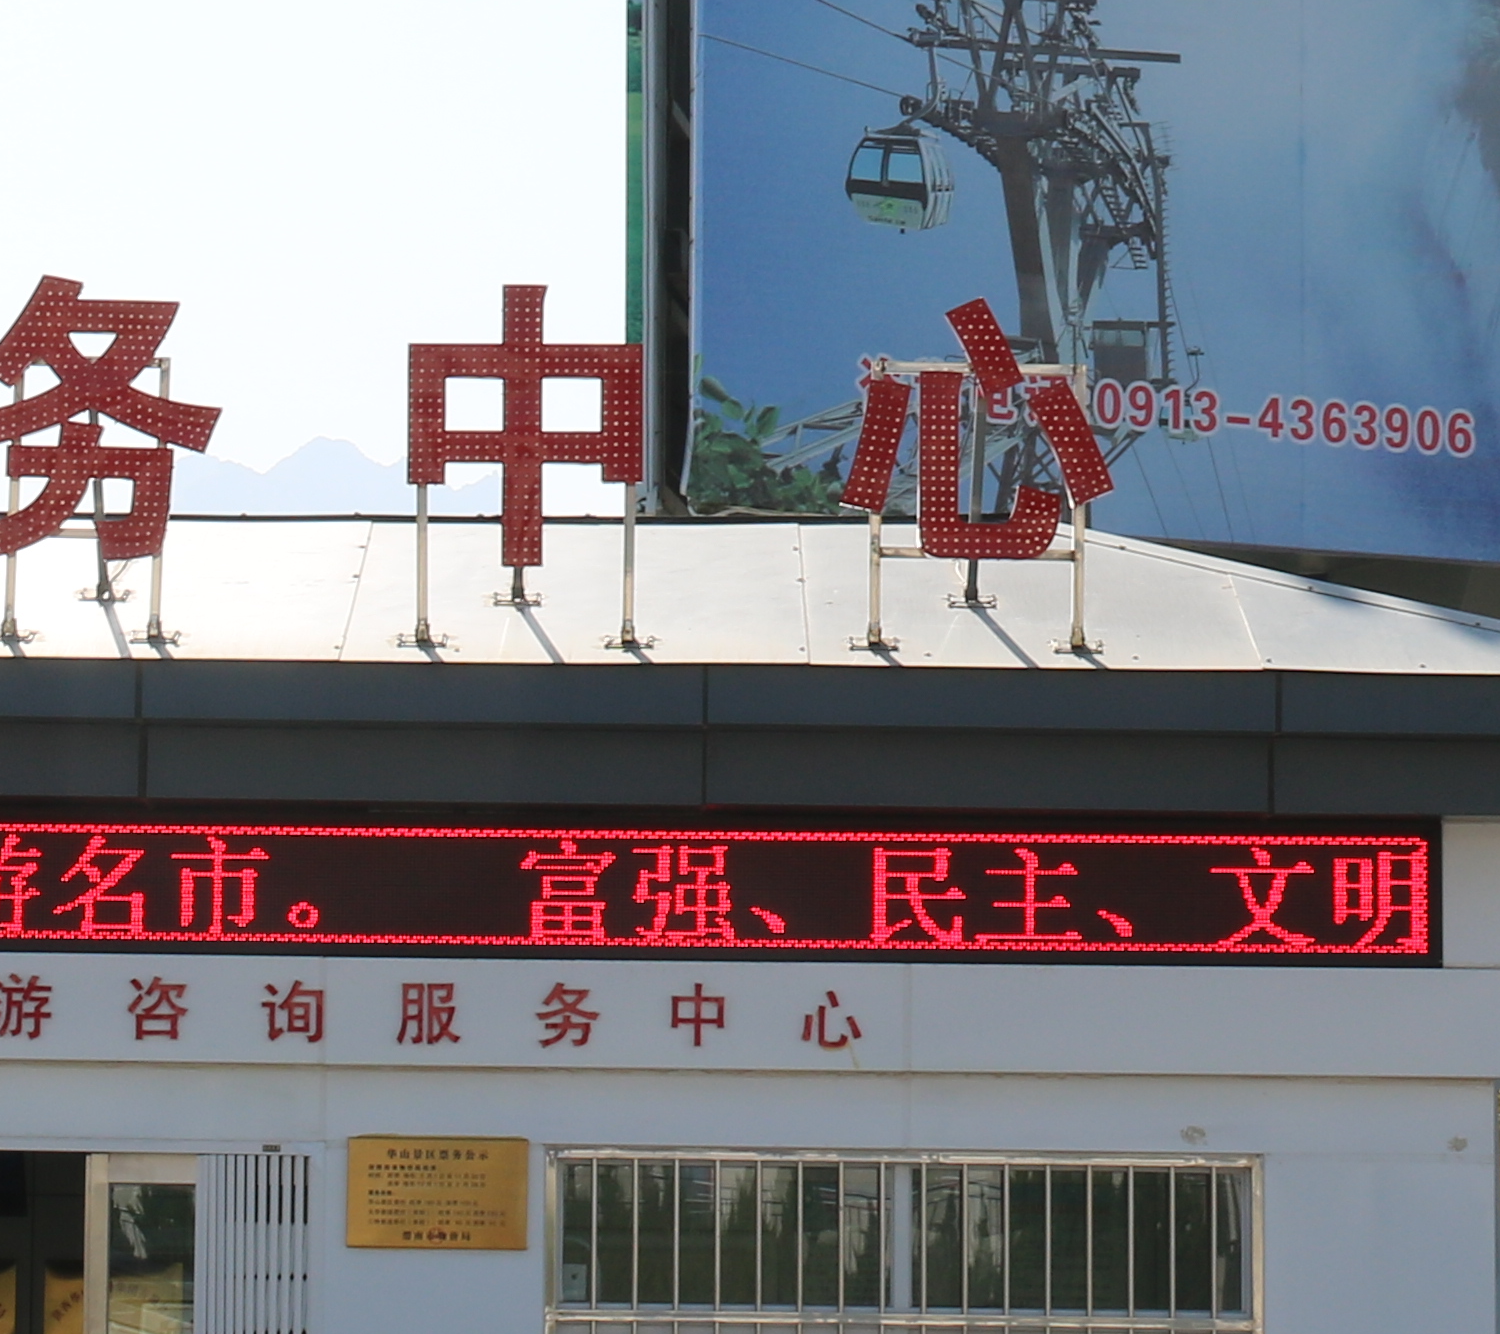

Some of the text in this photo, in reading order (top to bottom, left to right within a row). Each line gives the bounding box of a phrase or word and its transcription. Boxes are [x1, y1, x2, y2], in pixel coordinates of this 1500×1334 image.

[1093, 377, 1476, 458] 0913-4363906
[520, 839, 1427, 951] 富强、民主、文明
